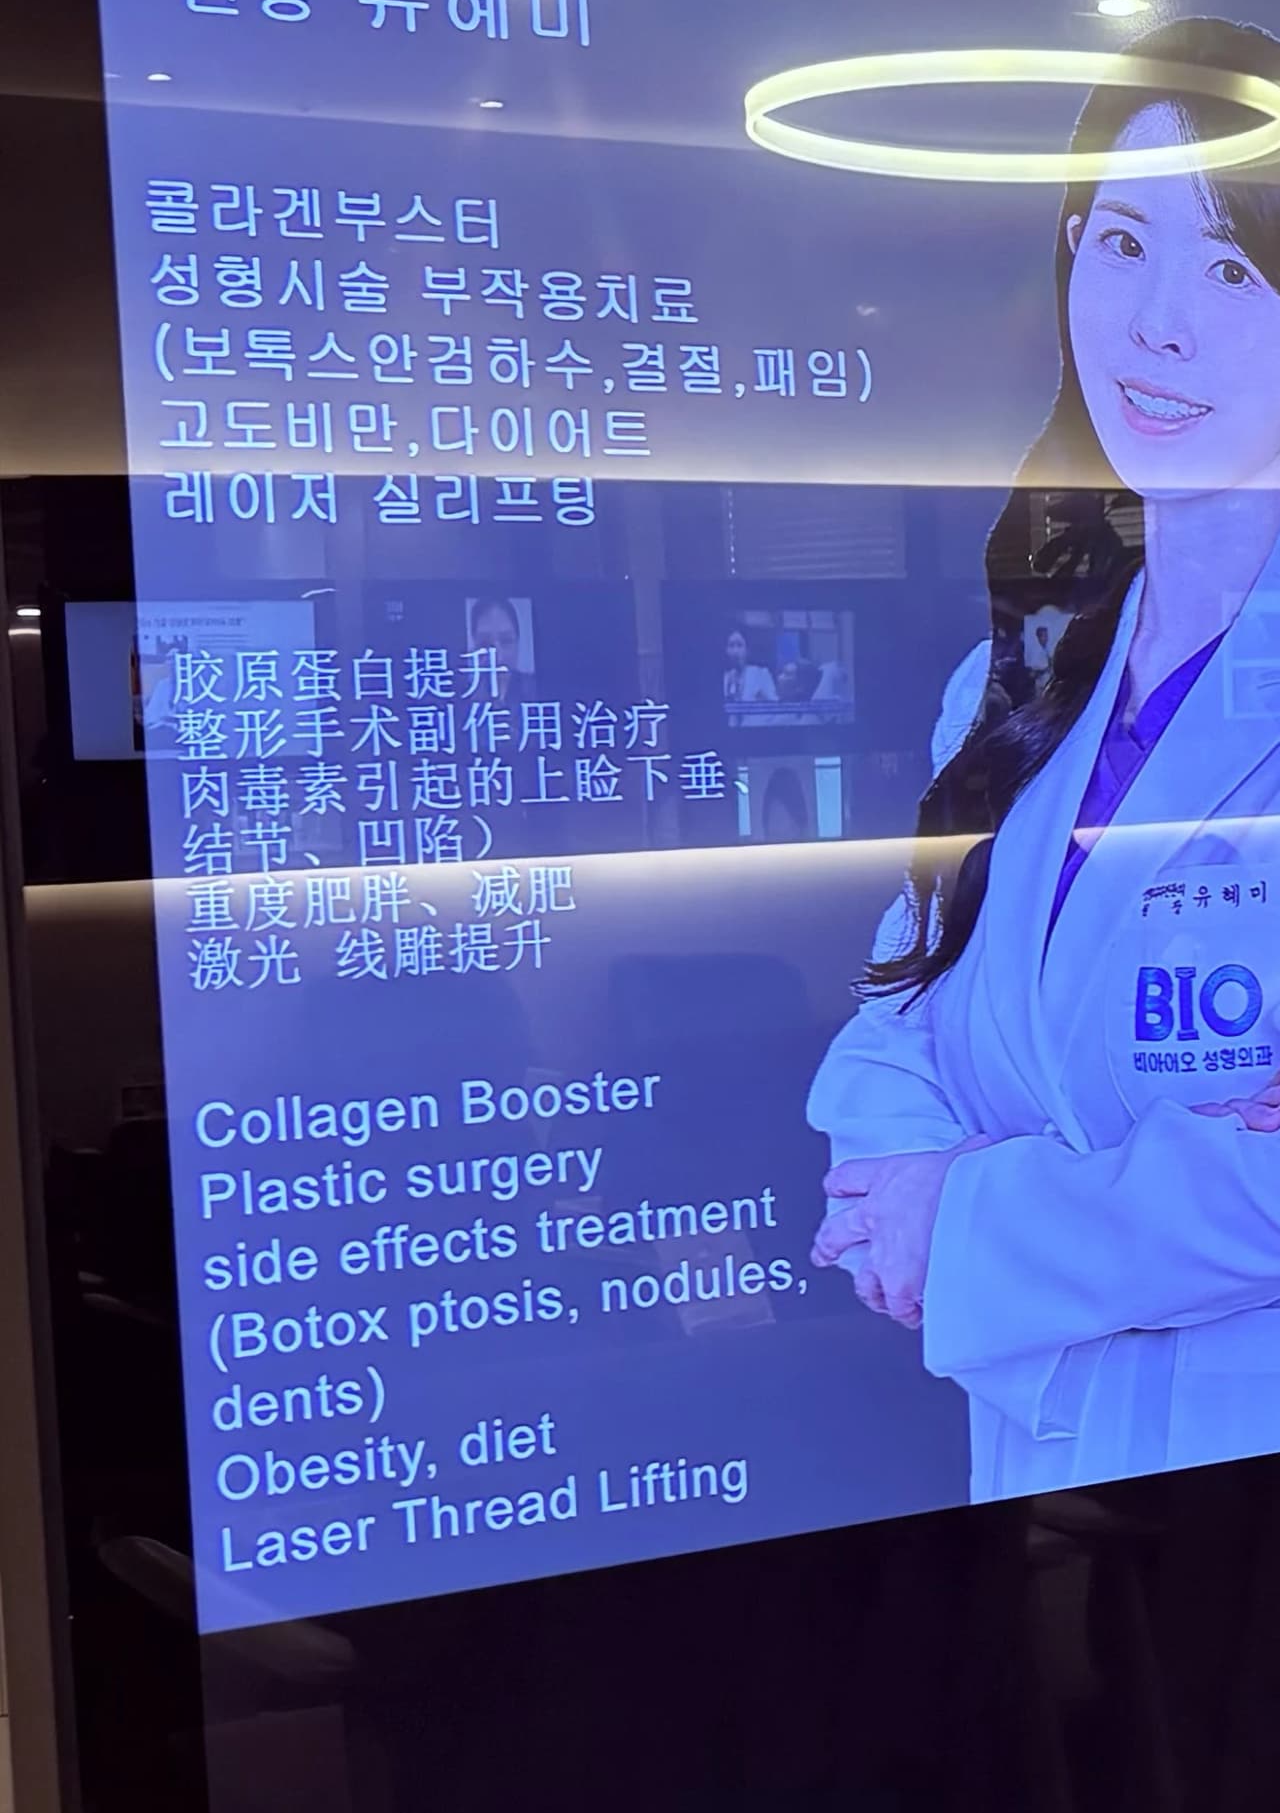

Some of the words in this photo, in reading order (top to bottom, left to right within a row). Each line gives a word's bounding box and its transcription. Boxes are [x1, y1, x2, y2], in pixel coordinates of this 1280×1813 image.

[145, 180, 500, 250] 콜라겐부스터
[150, 254, 391, 315] 성형시술
[421, 266, 698, 324] 부작용치료
[154, 322, 873, 403] (보톡스안검하수,결절,패임)
[160, 400, 653, 459] 고도비만,다이어트
[165, 472, 340, 526] 레이저
[375, 477, 598, 527] 실리프팅
[172, 649, 508, 704] 胶原蛋白提升
[174, 699, 669, 761] 整形手术副作用治疗
[186, 866, 575, 934] 重度肥胖、减肥
[189, 938, 301, 990] 激光
[336, 921, 551, 983] 线雕提升
[1134, 963, 1263, 1041] BIO
[197, 1092, 439, 1149] Collagen
[462, 1071, 661, 1125] Booster
[201, 1162, 387, 1219] Plastic
[406, 1146, 602, 1201] surgery
[203, 1242, 318, 1290] side
[340, 1220, 518, 1275] effects
[537, 1187, 777, 1255] treatment
[208, 1305, 389, 1372] (Botox
[409, 1282, 580, 1348] ptosis,
[601, 1254, 808, 1314] nodules,
[212, 1367, 386, 1431] dents)
[217, 1436, 439, 1501] Obesity,
[459, 1413, 556, 1467] diet
[222, 1513, 375, 1572] Laser
[393, 1476, 577, 1544] Thread
[600, 1456, 749, 1514] Lifting
